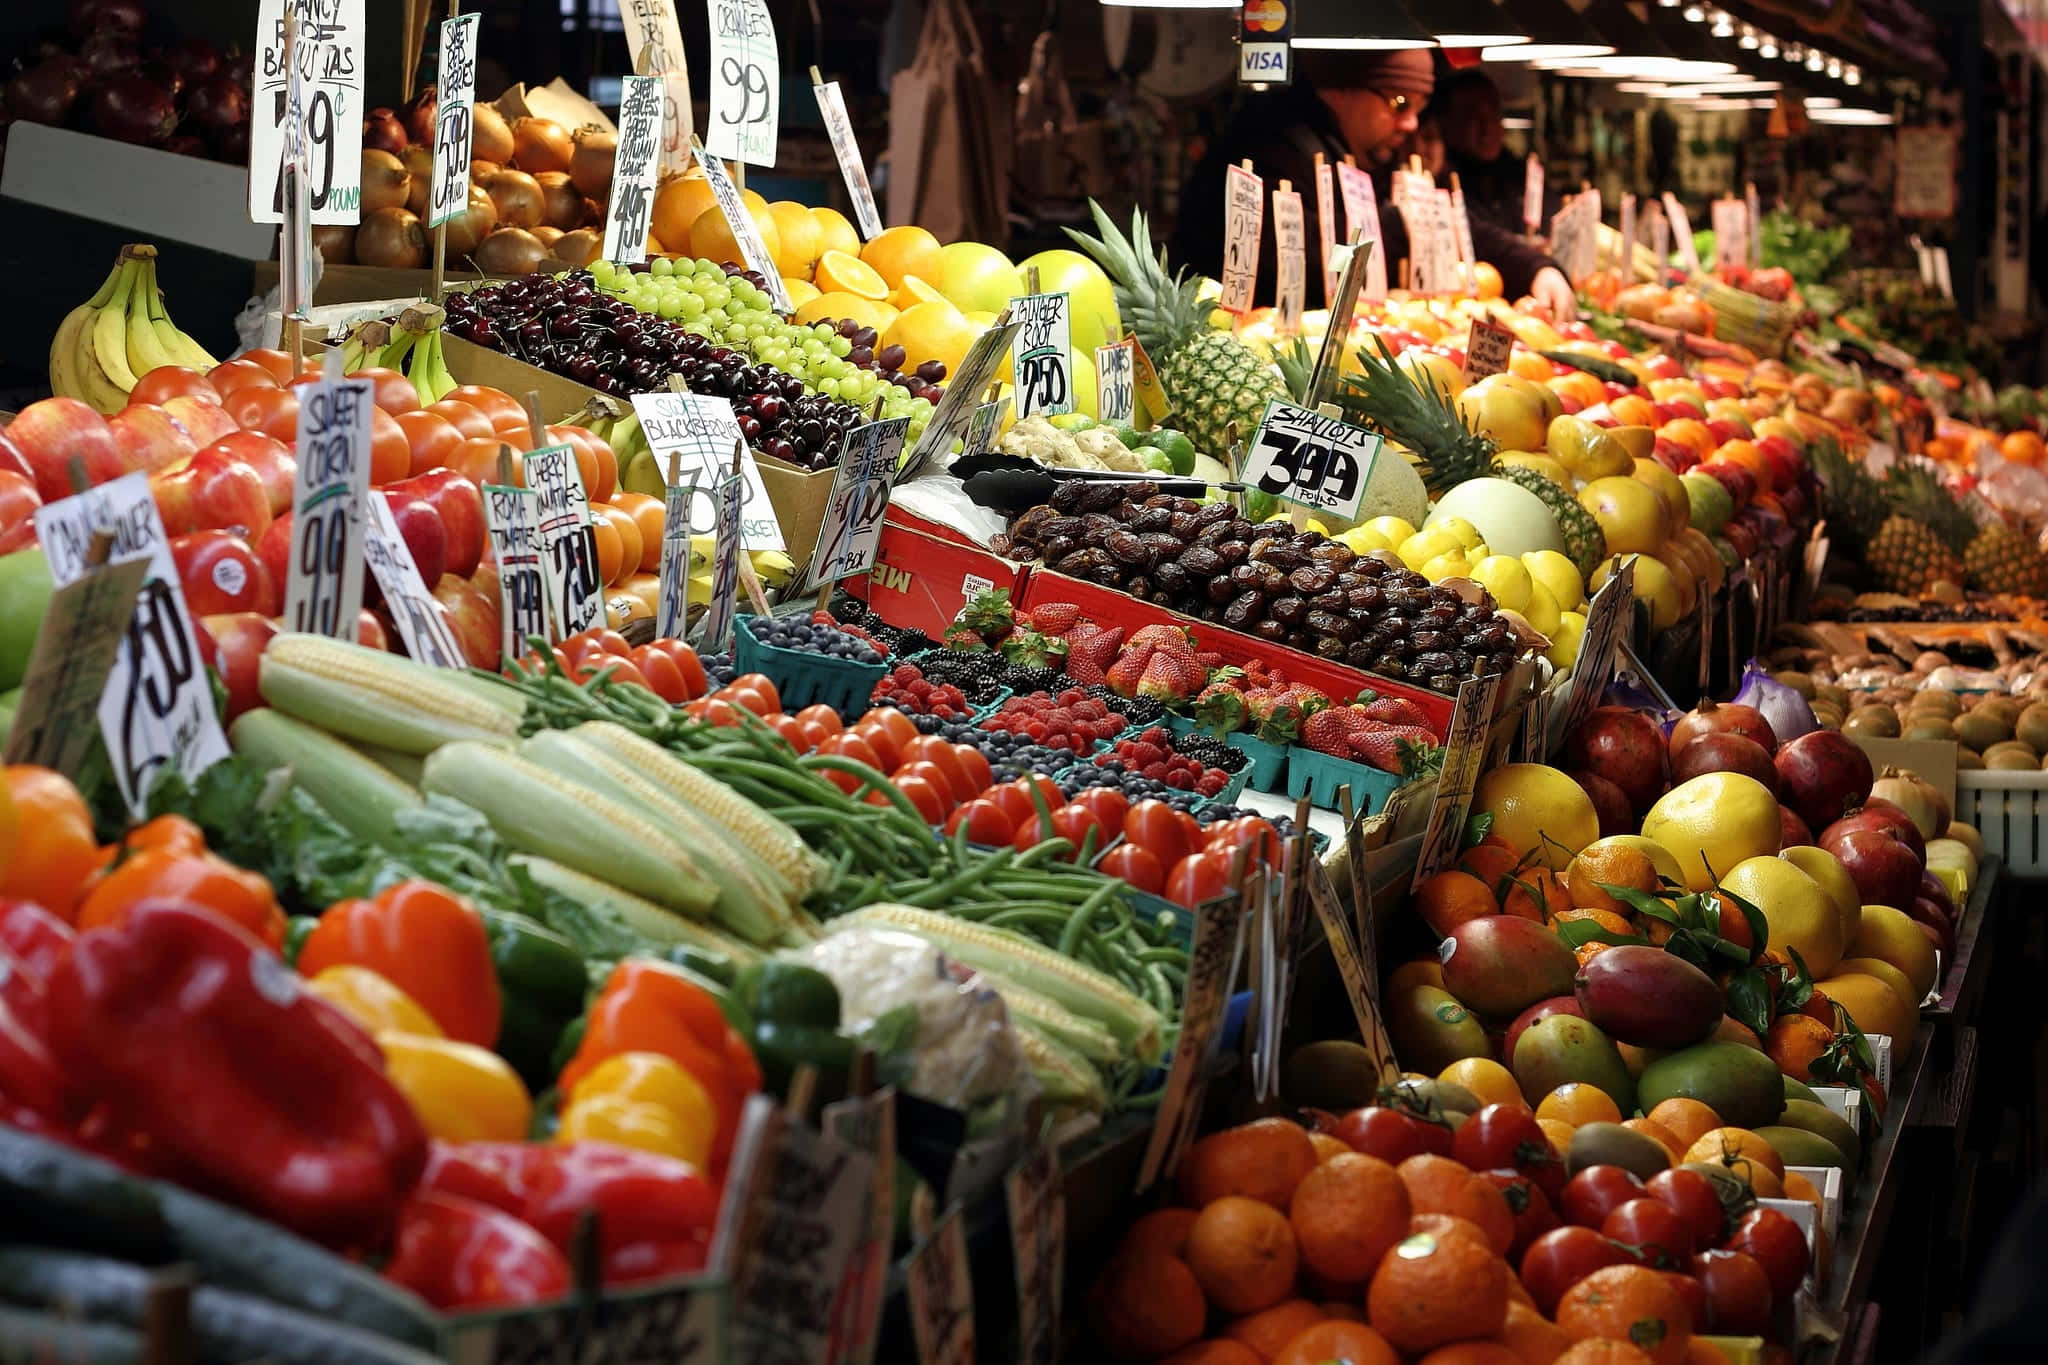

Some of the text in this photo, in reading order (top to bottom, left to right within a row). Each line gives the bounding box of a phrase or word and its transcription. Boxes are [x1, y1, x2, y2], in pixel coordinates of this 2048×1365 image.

[275, 19, 346, 49] RPE
[1244, 51, 1284, 70] VISA
[1018, 296, 1064, 322] GINGER
[1023, 321, 1056, 351] ROOT
[644, 418, 744, 442] BLACKBERRIES
[1271, 408, 1371, 447] SHALLOTS
[1300, 488, 1338, 507] POUND
[741, 518, 777, 538] SKET
[843, 548, 867, 572] BOX
[965, 582, 983, 594] ore
